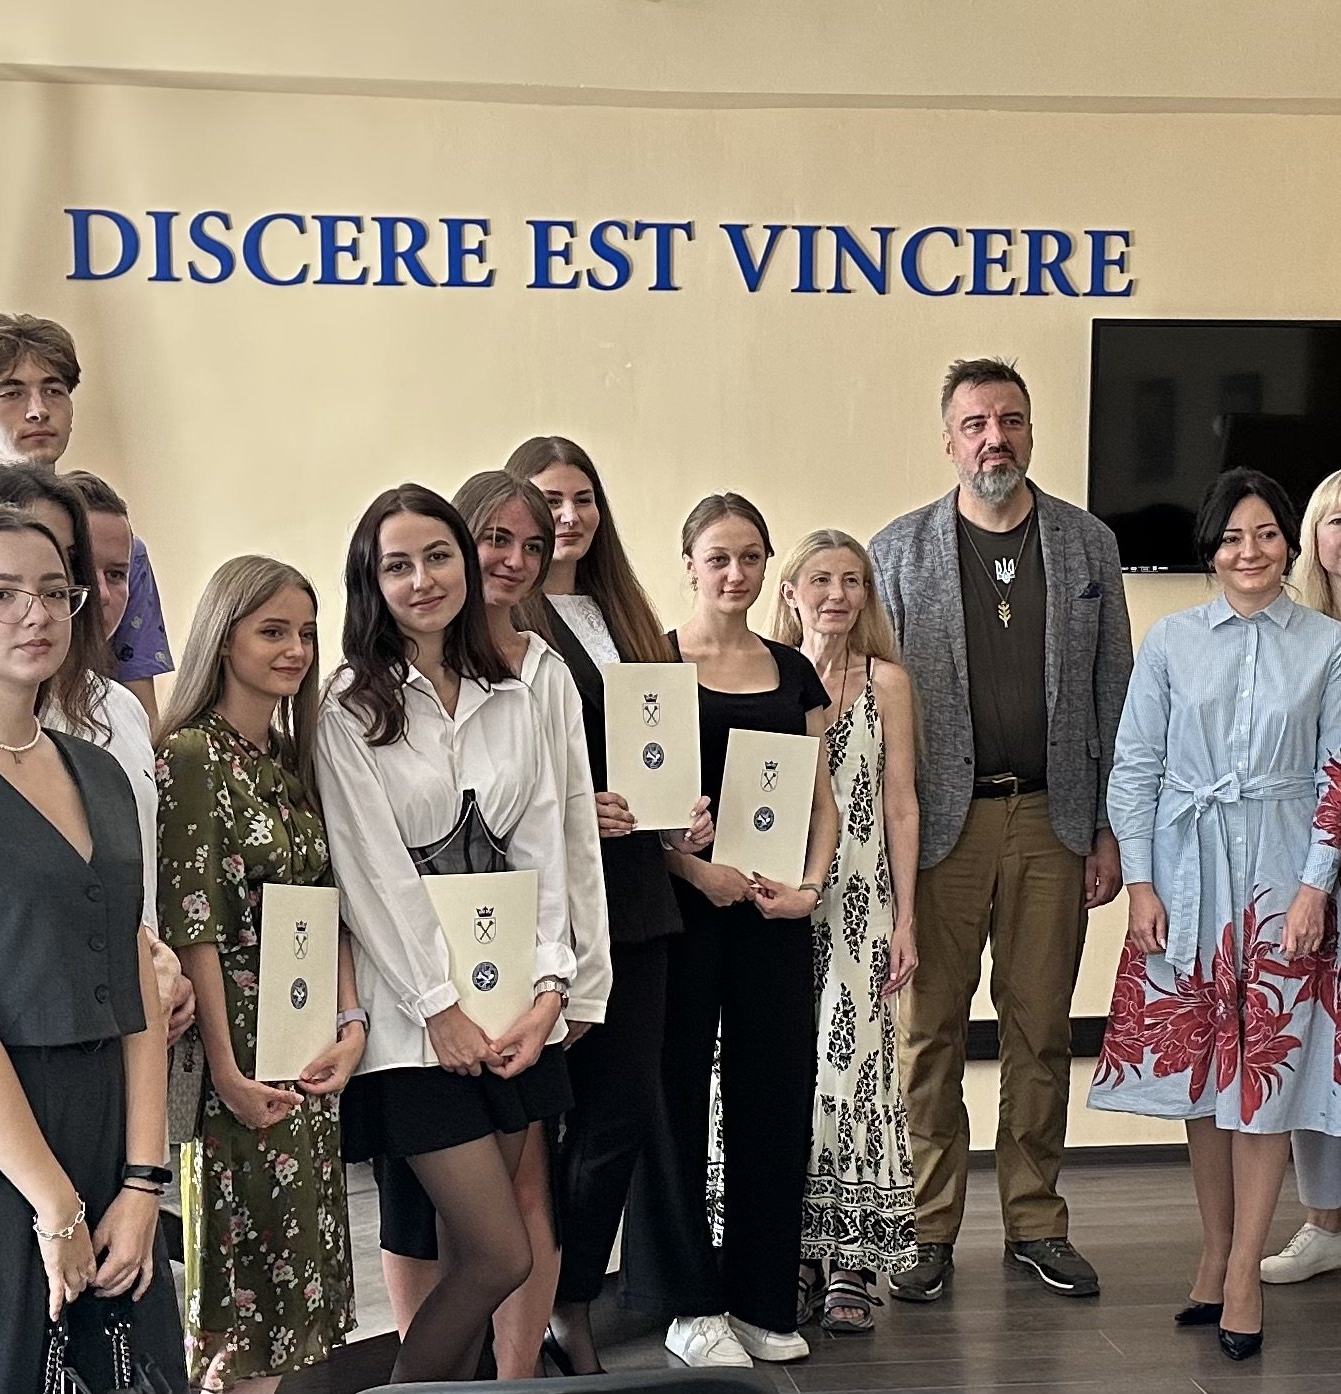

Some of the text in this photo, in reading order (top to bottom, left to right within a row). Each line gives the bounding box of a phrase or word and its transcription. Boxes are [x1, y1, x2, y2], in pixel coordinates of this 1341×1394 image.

[65, 209, 1136, 297] DISCERE EST VINCERE
